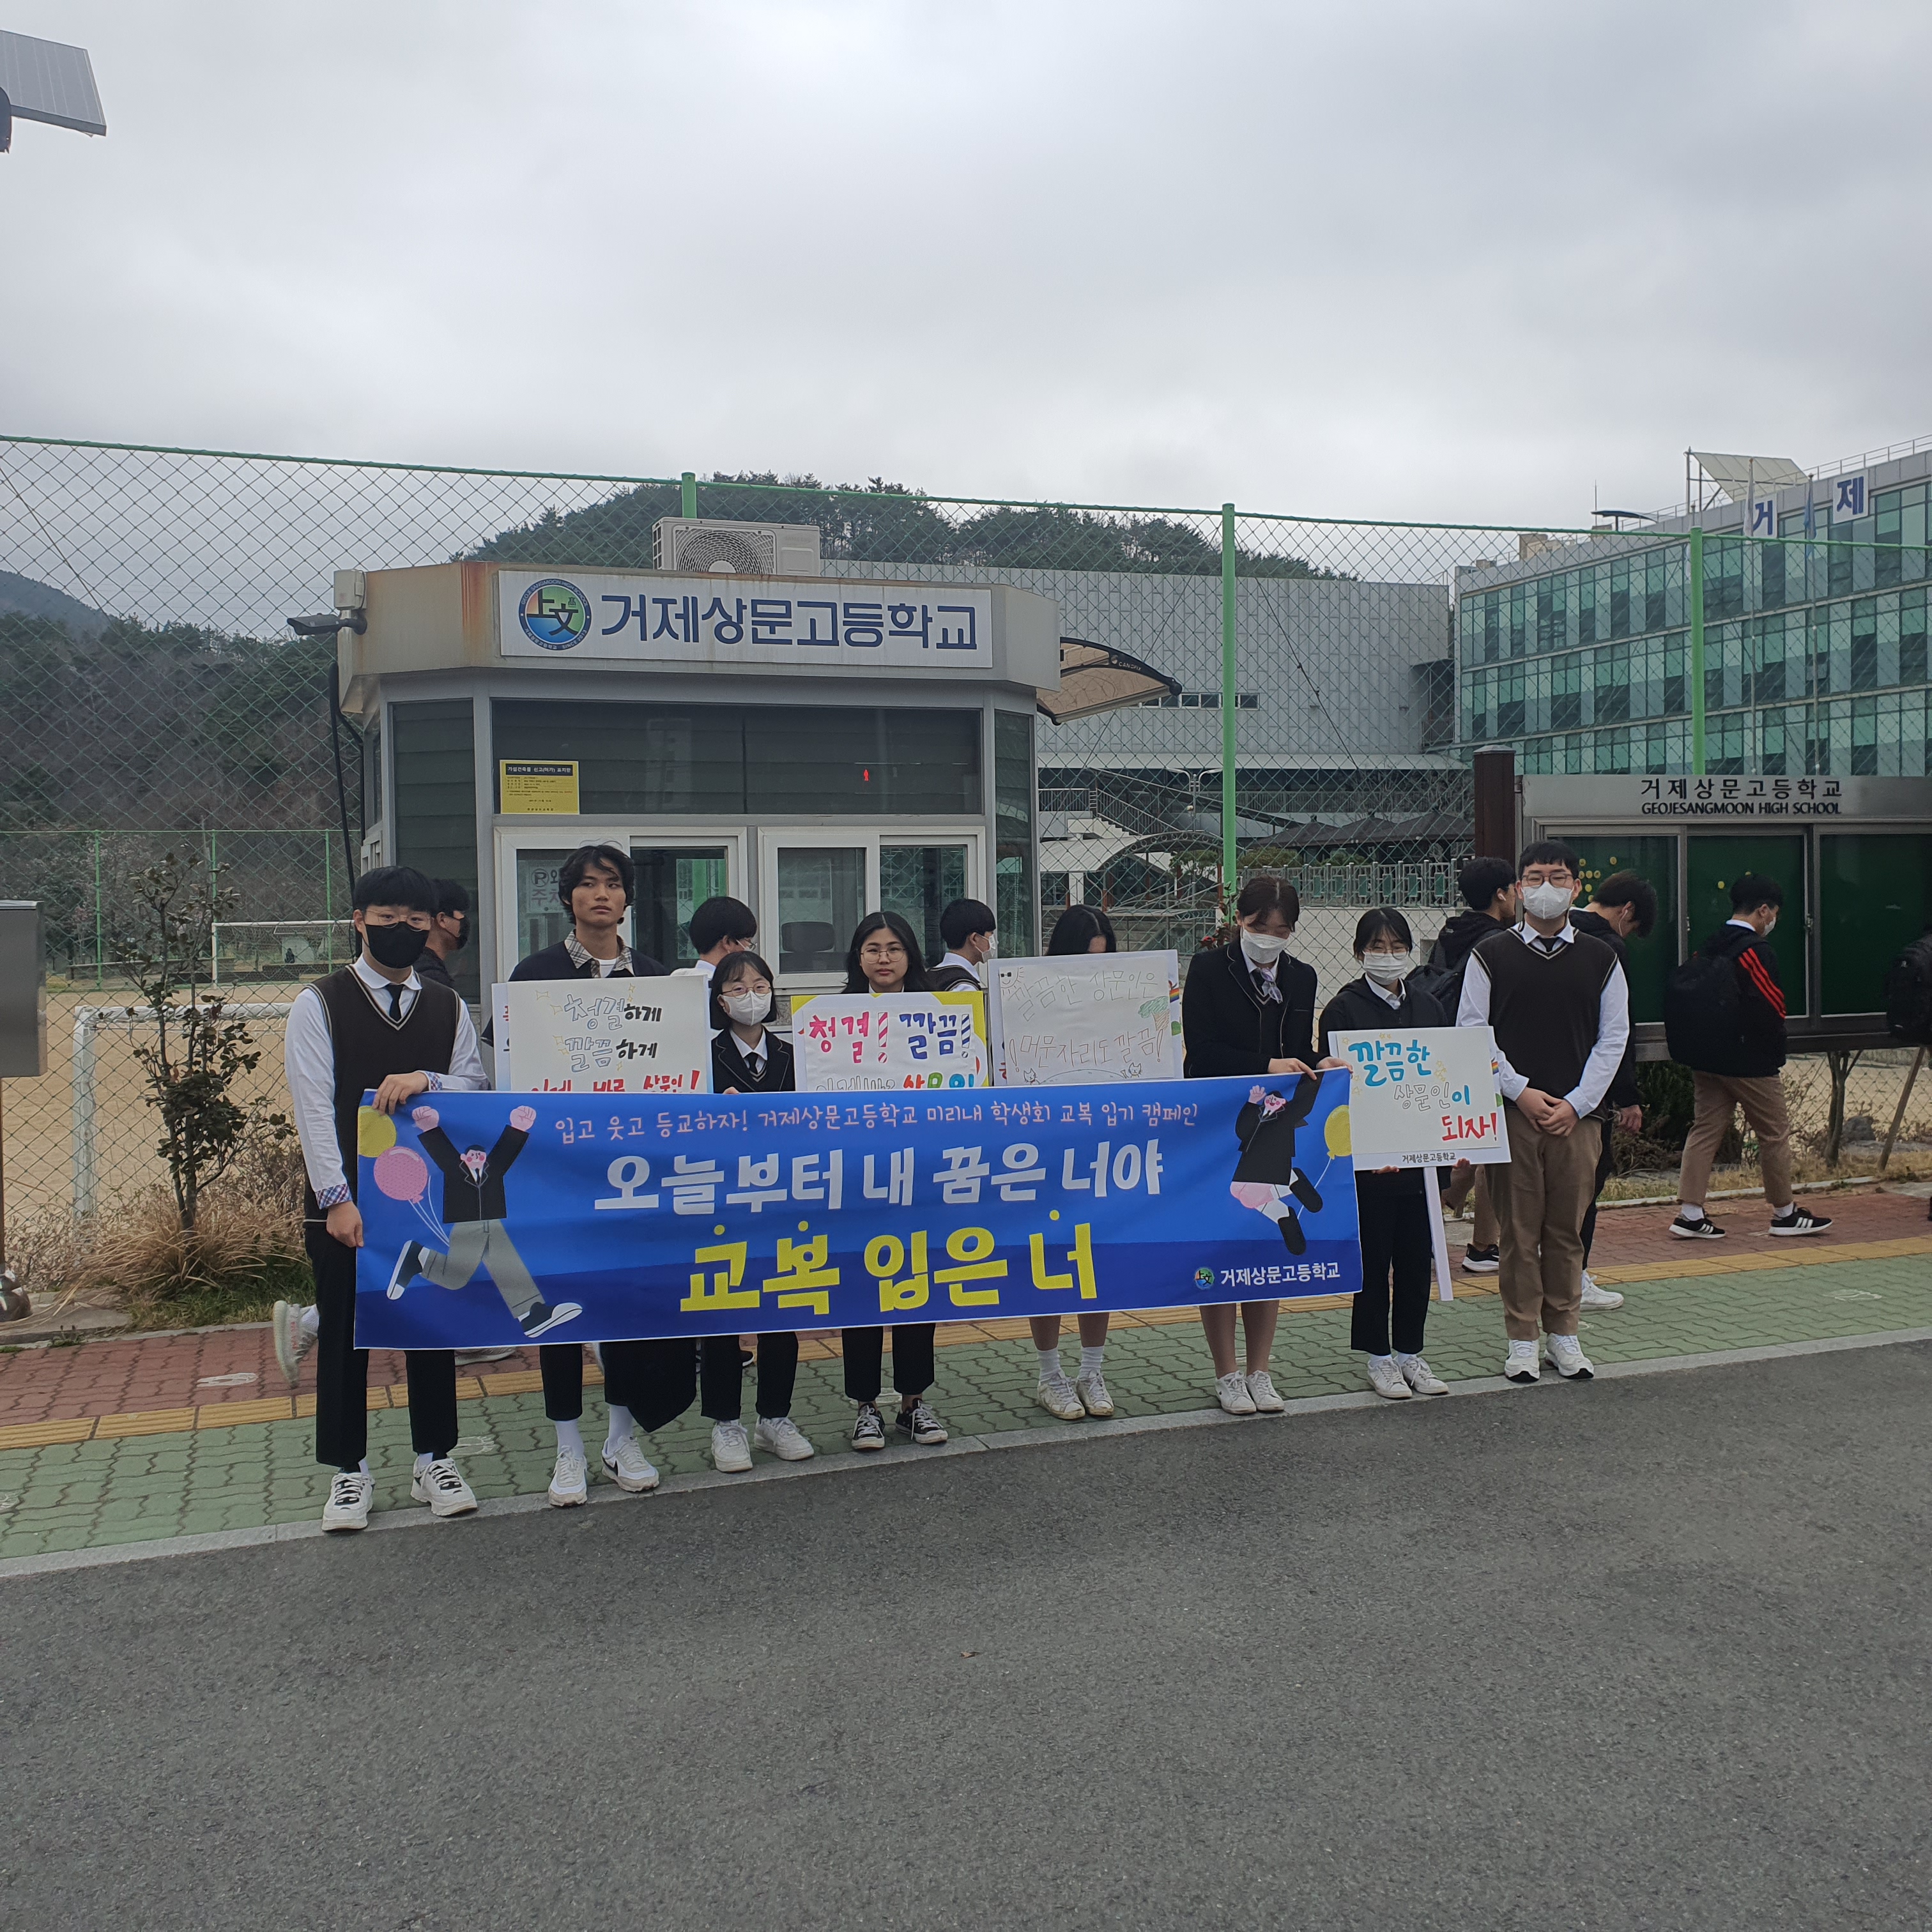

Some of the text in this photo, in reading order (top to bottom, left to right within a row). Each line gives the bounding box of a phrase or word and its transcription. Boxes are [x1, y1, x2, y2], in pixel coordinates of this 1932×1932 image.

[1836, 476, 1864, 515] 제
[601, 594, 978, 650] 거제상문고등학교
[1640, 778, 1843, 800] 거제상문고등학교
[1641, 802, 1842, 815] GEOJESANGMOON HIGH SCHOOL
[1089, 970, 1158, 1001] 상문인은
[564, 993, 663, 1031] 청결하게
[564, 1036, 658, 1073] 깔끔하게
[808, 1011, 971, 1064] 청결! 깔끔!
[1347, 1039, 1432, 1087] 깔끔한
[1393, 1082, 1471, 1112] 상문인이
[555, 1100, 1199, 1146] 입고 웃고 등교하자! 거제상문고등학교 미리내 학생회 교복 입기 캠페인
[1441, 1112, 1498, 1142] 되자!
[1401, 1152, 1457, 1163] 거제상문고등학교
[594, 1138, 1163, 1215] 오늘부터 내 꿈은 너야
[680, 1222, 1098, 1316] 교복 입은 너
[1220, 1261, 1342, 1287] 거제상문고등학교
